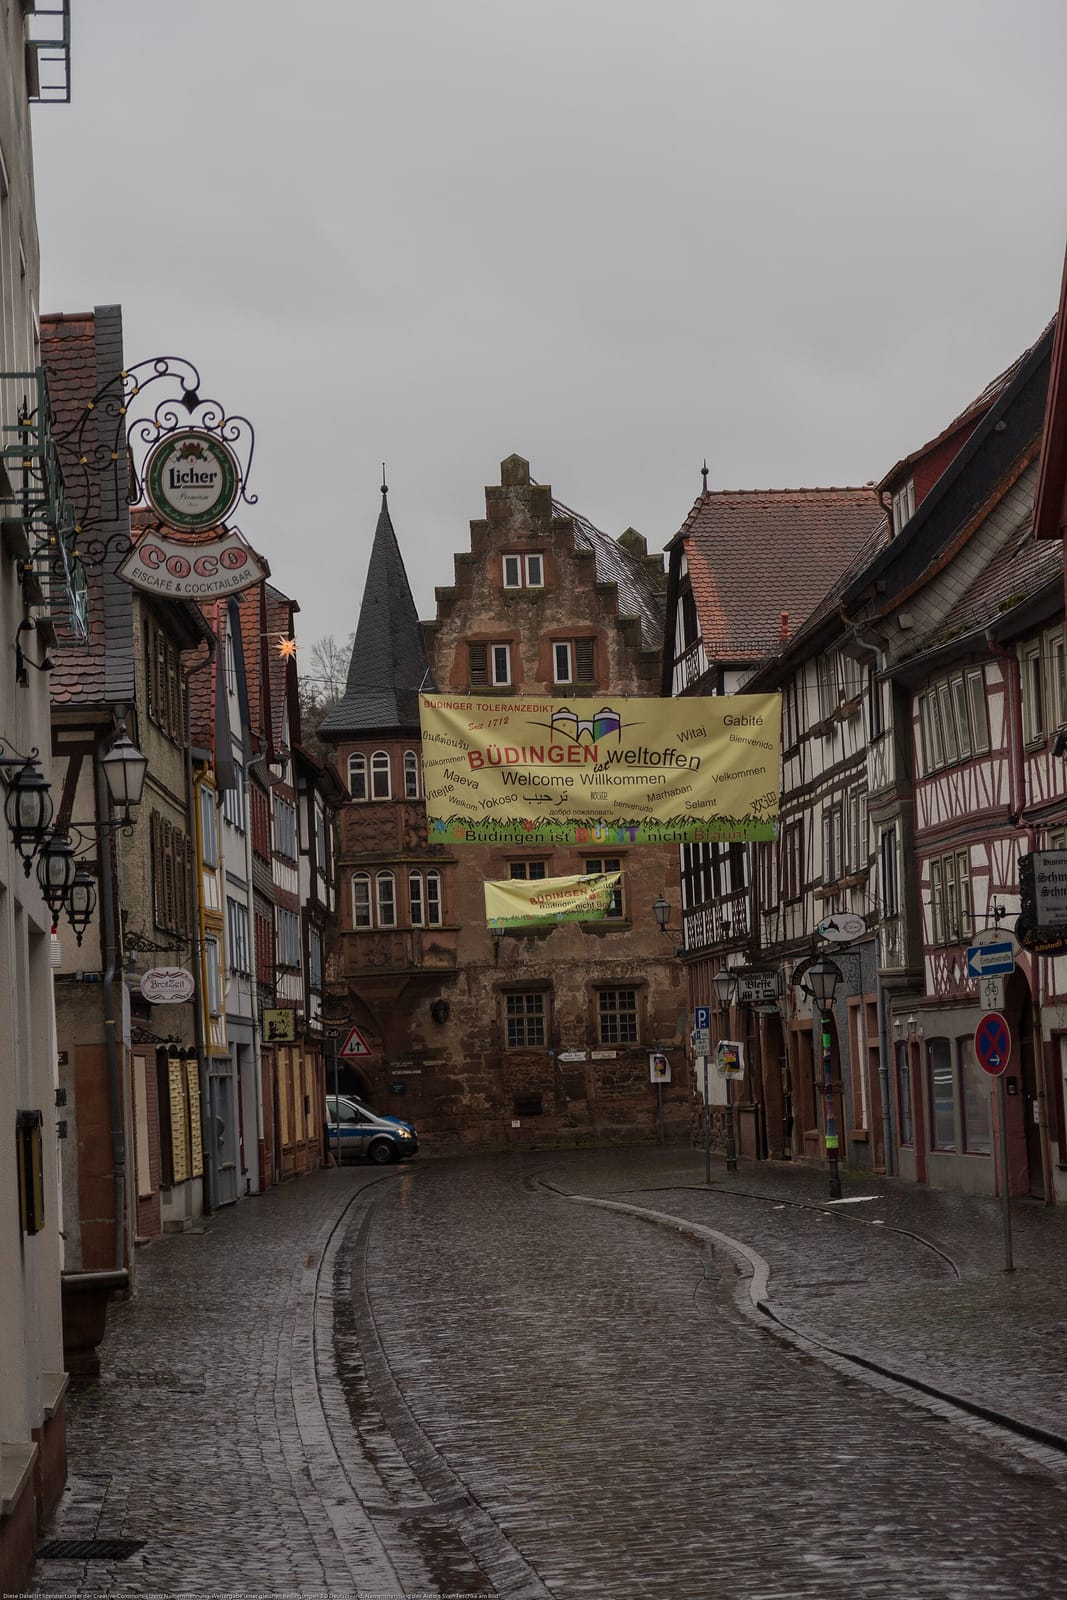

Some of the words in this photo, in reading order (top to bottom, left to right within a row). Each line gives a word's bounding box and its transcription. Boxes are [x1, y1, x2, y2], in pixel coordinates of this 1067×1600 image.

[169, 467, 218, 489] Licher
[139, 544, 247, 578] COCO
[132, 567, 173, 590] EISCAFÉ
[175, 583, 183, 592] &
[185, 570, 253, 594] COCKTAILBAR
[476, 703, 554, 713] TOLERANZEDIKT
[468, 722, 484, 731] Seit
[487, 717, 510, 728] 1712
[723, 714, 763, 726] Gabité
[677, 725, 707, 743] Witaj
[729, 733, 774, 750] Bienvenido
[468, 744, 598, 770] BÜDINGEN
[594, 760, 610, 773] ist
[607, 746, 701, 770] weltoffen
[443, 768, 479, 789] Maeva
[501, 771, 574, 787] Welcome
[579, 773, 666, 786] Willkommen
[711, 766, 766, 784] Velkommen
[478, 793, 518, 810] Yokoso
[647, 784, 693, 803] Marhaban
[465, 830, 544, 845] Büdingen
[550, 830, 569, 842] ist
[648, 829, 687, 842] nicht
[698, 1010, 707, 1028] P
